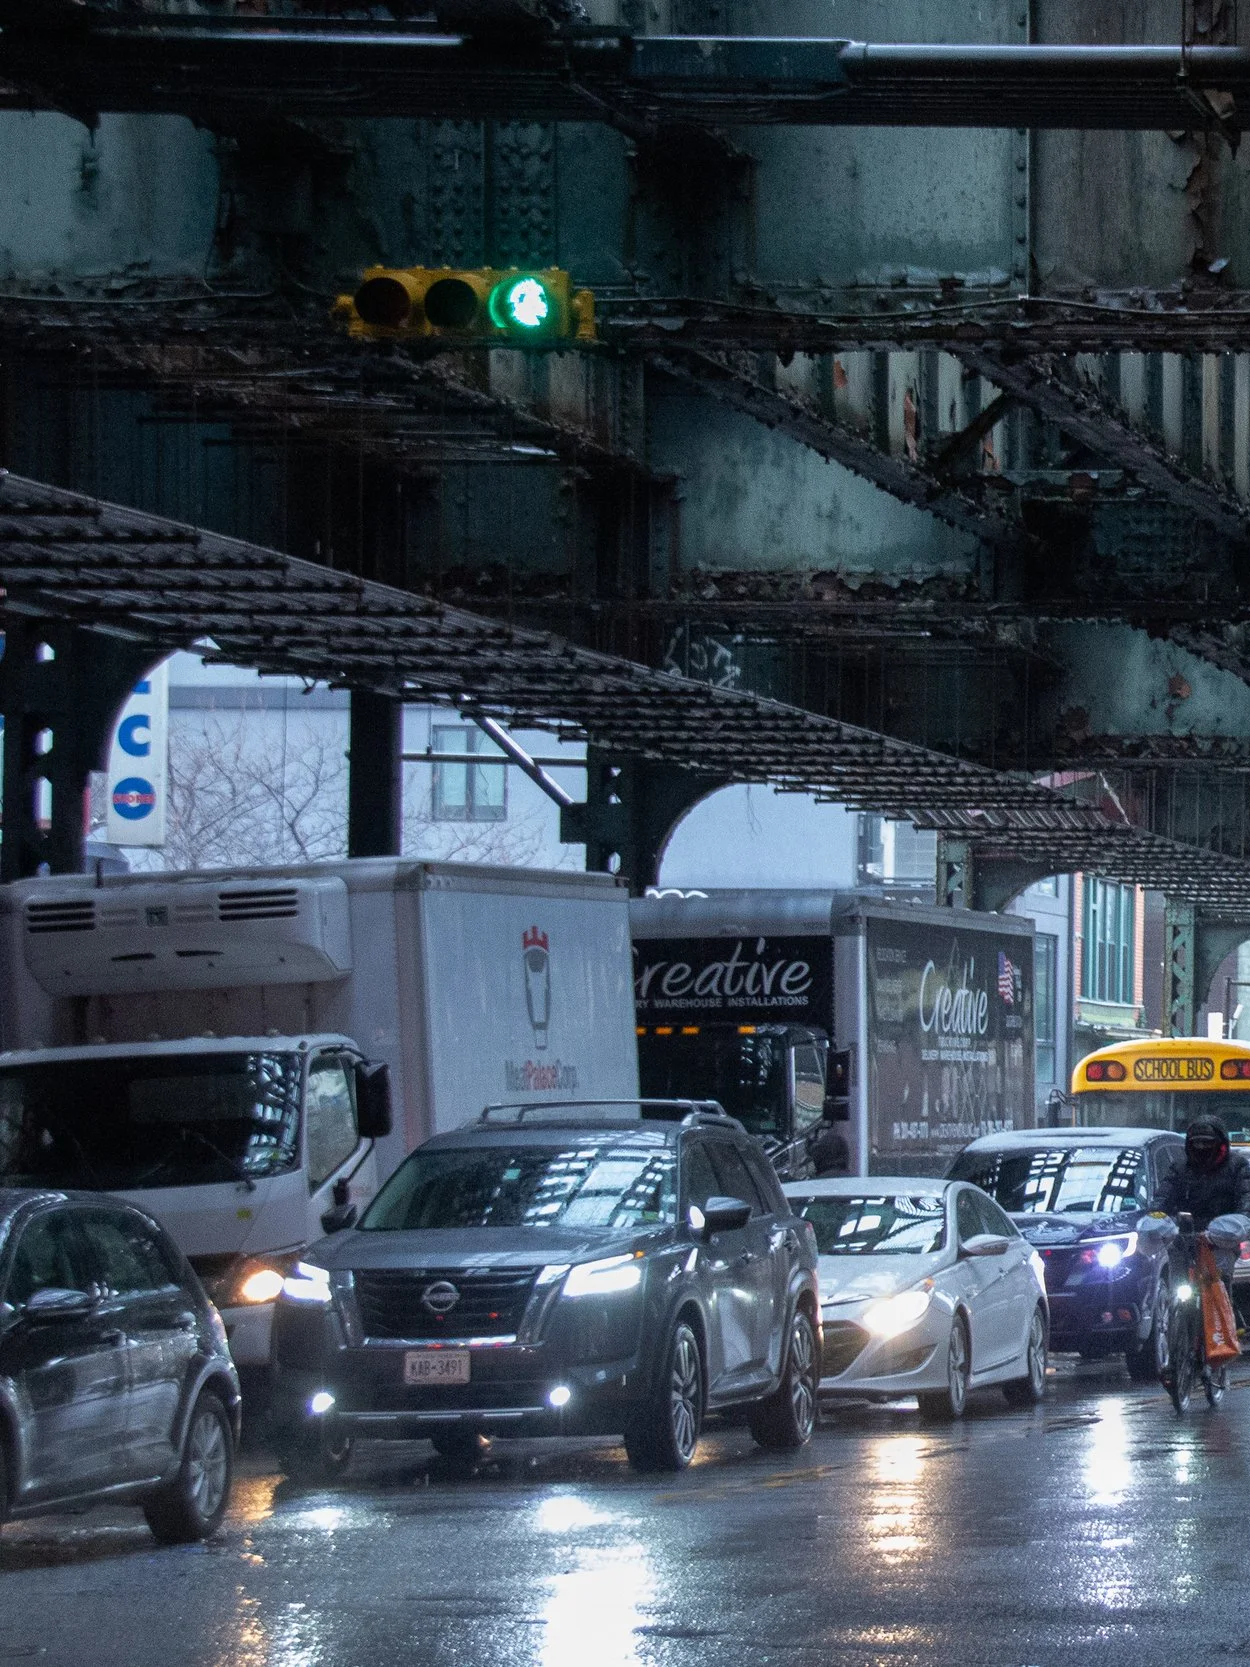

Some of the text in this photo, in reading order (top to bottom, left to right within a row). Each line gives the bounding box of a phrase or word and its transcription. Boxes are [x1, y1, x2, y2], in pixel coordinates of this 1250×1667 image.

[633, 938, 813, 999] reative
[654, 997, 723, 1009] WAREHOUSE
[727, 995, 809, 1007] INSTALLATIONS
[920, 955, 989, 1034] Creative
[1136, 1060, 1212, 1079] SCHOOL BUS
